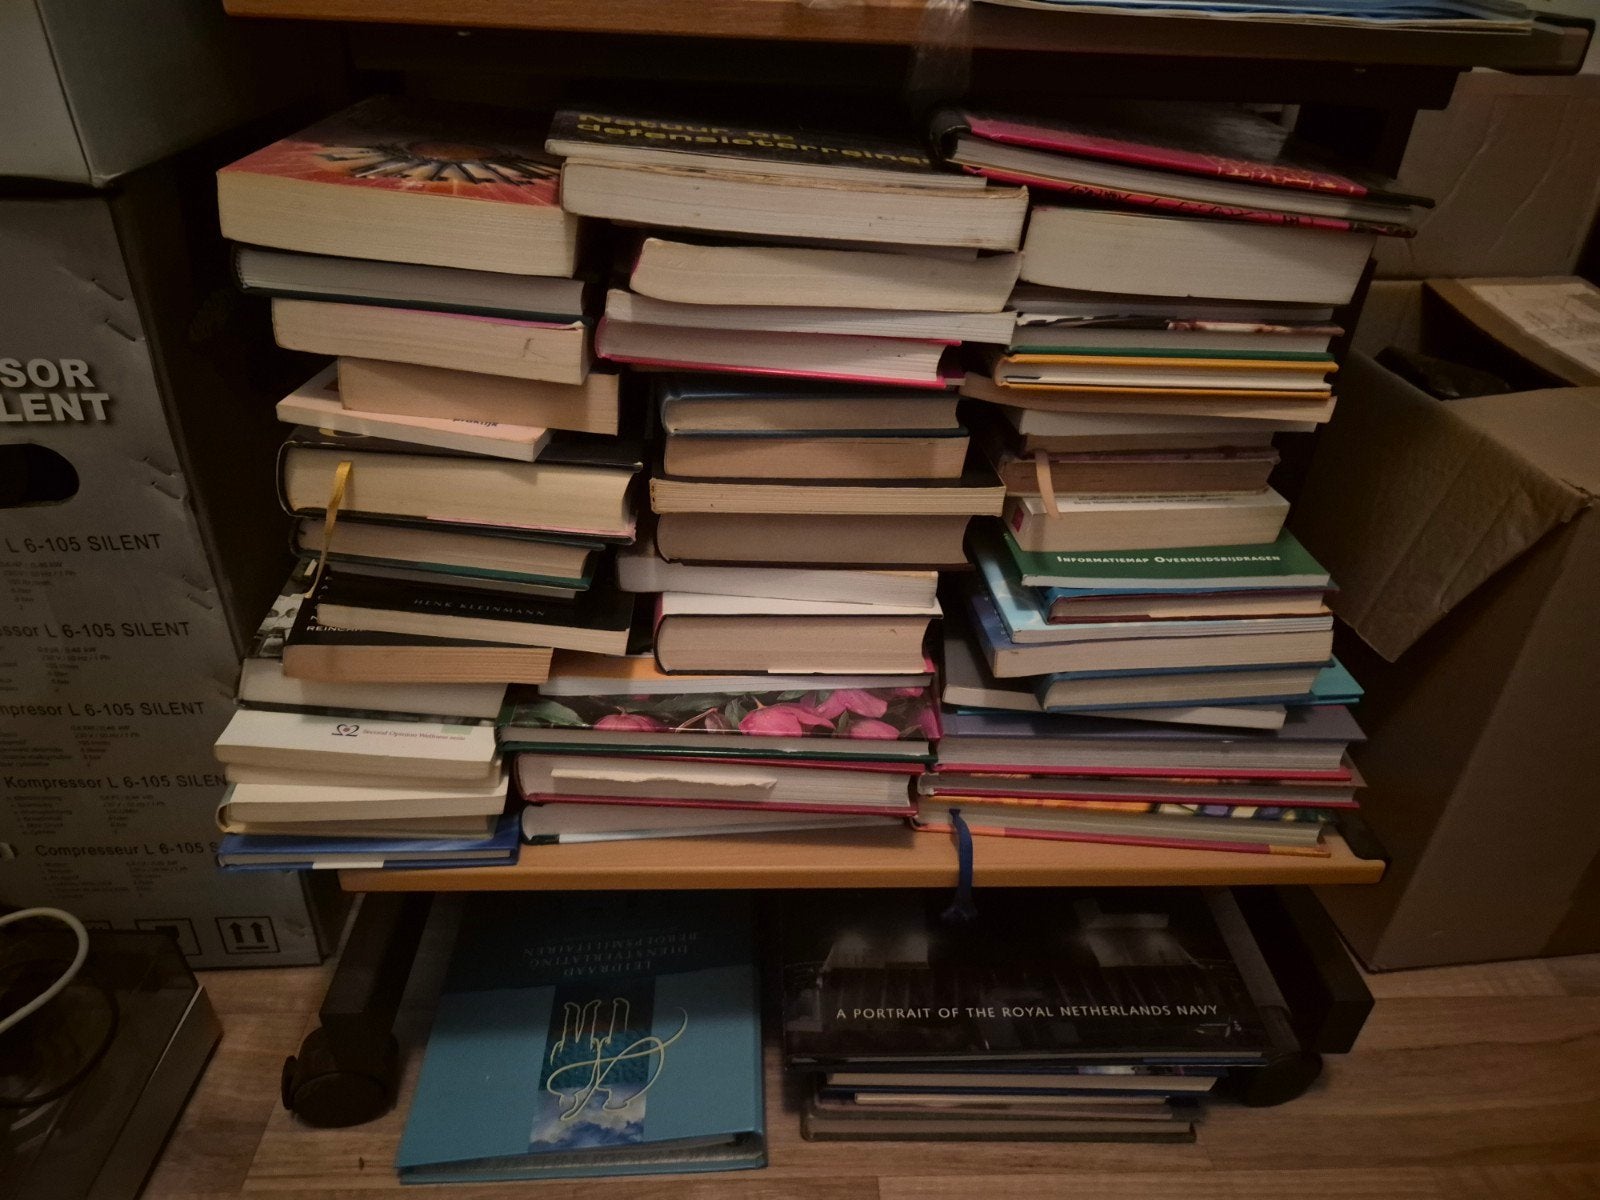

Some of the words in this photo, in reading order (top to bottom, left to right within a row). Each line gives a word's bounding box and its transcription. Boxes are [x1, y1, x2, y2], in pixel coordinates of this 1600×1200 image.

[0, 357, 96, 388] SOR
[0, 392, 111, 422] LENT
[5, 537, 20, 553] L
[24, 535, 82, 554] 6-105
[87, 533, 161, 552] SILENT
[44, 622, 58, 639] L
[62, 623, 116, 639] 6-105
[121, 621, 190, 638] SILENT
[68, 702, 81, 717] L
[84, 702, 135, 718] 6-105
[140, 701, 205, 717] SILENT
[3, 776, 102, 791] Kompressor
[106, 776, 120, 789] L
[123, 775, 172, 789] 6-105
[35, 844, 139, 858] Compresseur
[143, 844, 153, 856] L
[159, 842, 205, 855] 6-105
[835, 1008, 848, 1020] A
[852, 1007, 932, 1019] PORTRAIT
[938, 1007, 960, 1019] OF
[965, 1006, 997, 1018] THE
[1002, 1005, 1055, 1018] ROYAL
[1059, 1004, 1173, 1017] NETHERLANDS
[1175, 1004, 1219, 1016] NAVY
